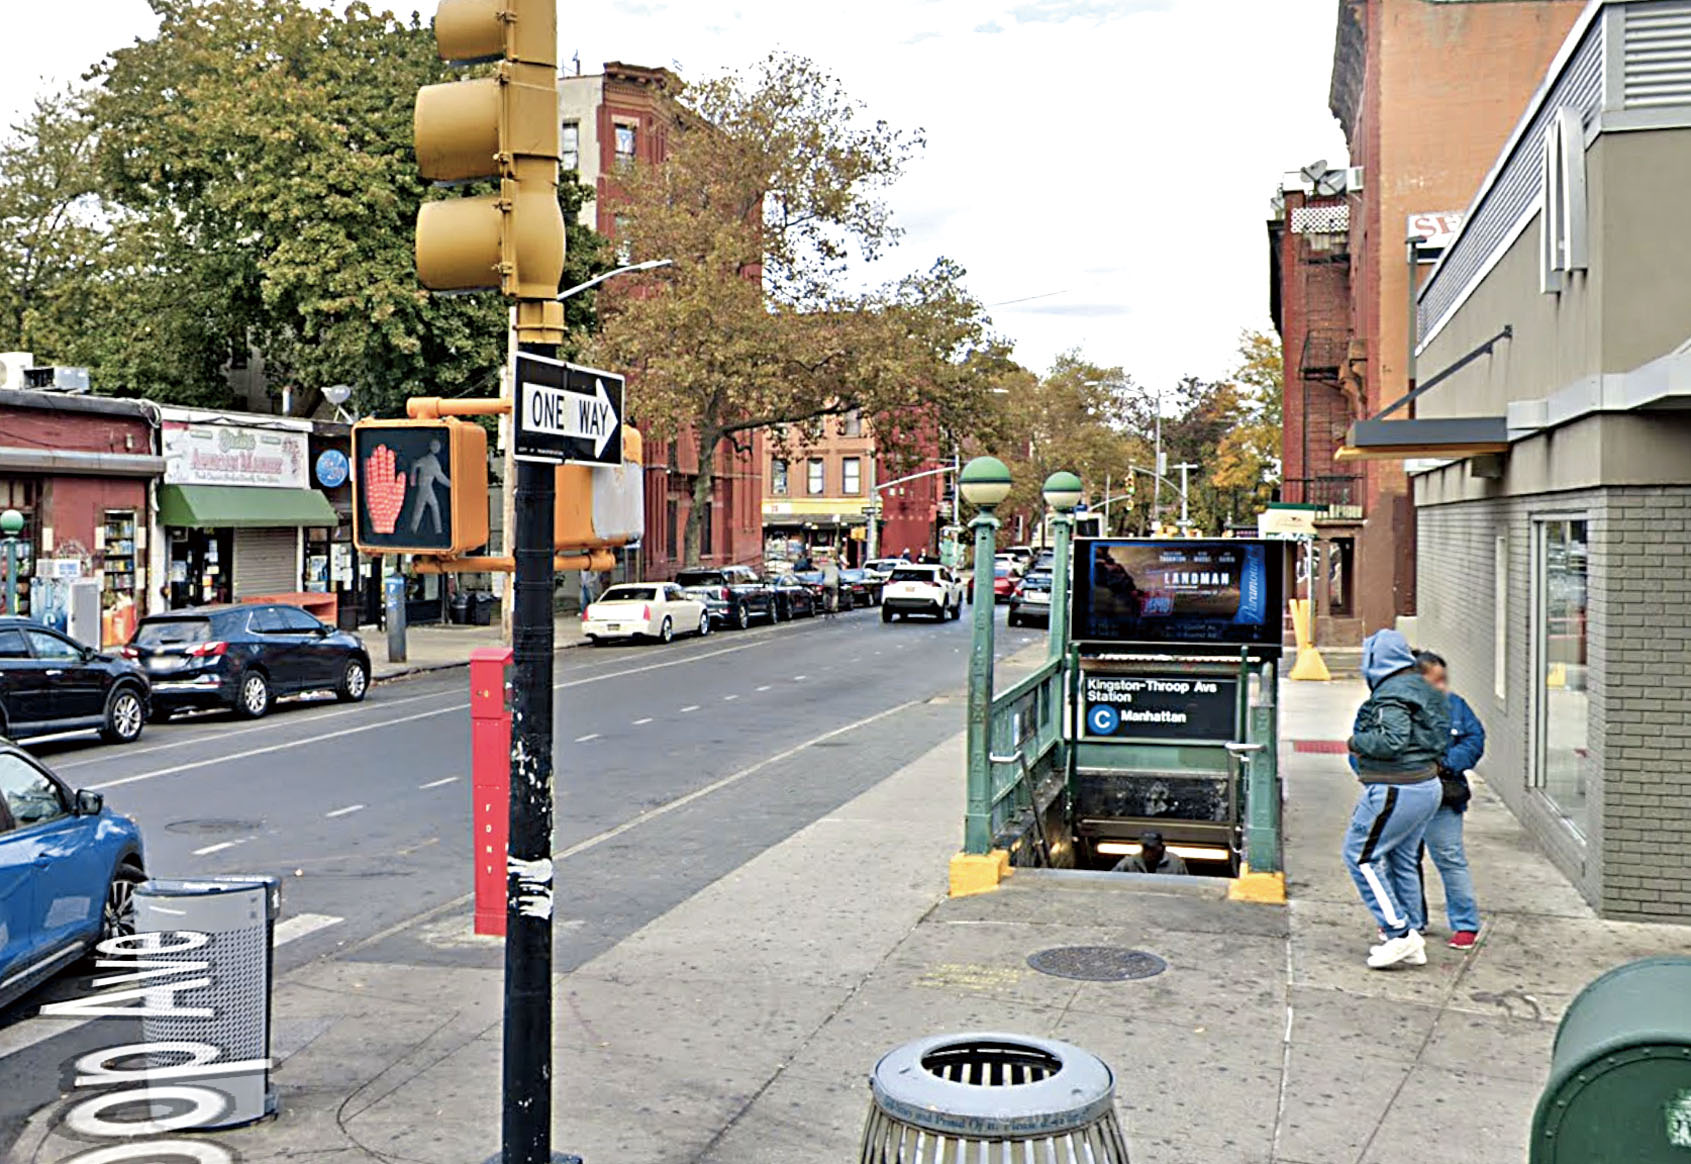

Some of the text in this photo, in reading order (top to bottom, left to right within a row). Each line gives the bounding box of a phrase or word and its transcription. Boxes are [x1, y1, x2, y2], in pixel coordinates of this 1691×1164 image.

[532, 390, 609, 436] ONE WAY
[1164, 572, 1230, 585] LANDMAN
[1240, 555, 1262, 621] Paramount
[1087, 679, 1217, 694] Kingston-Throop Avs
[1087, 691, 1132, 702] Station
[1094, 709, 1186, 728] C Manhattan
